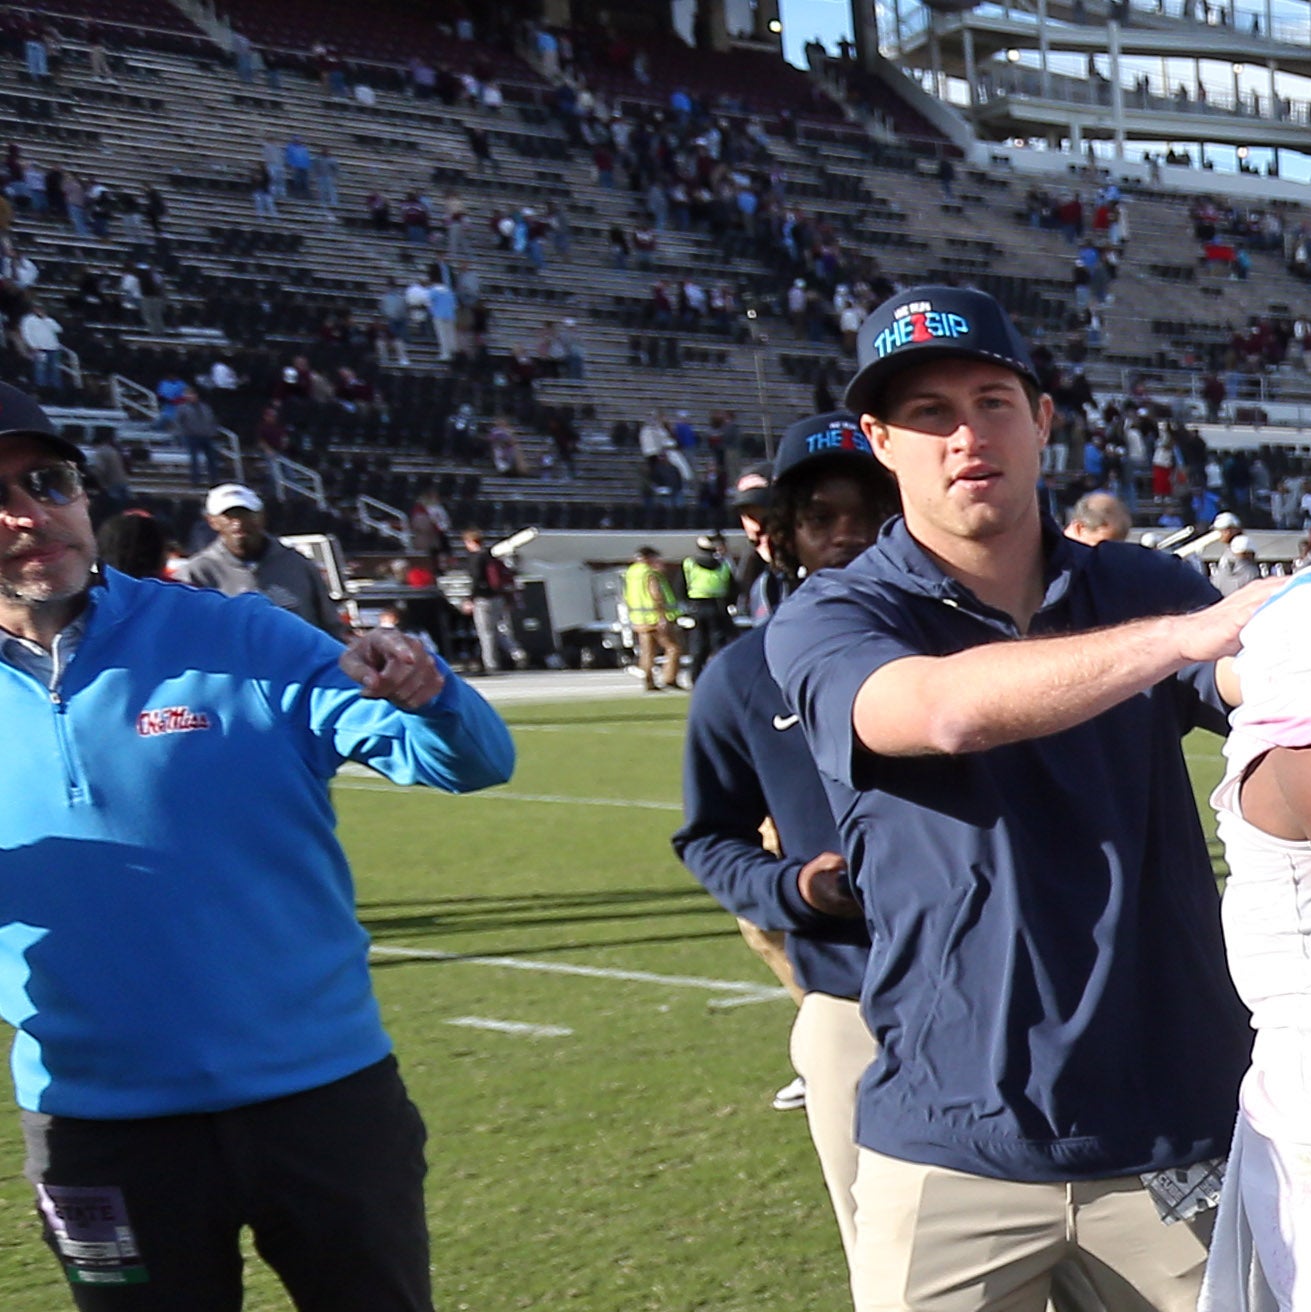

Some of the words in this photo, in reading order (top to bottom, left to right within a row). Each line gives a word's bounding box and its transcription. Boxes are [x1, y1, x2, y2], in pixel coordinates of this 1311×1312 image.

[874, 315, 914, 358] THE
[924, 311, 969, 338] SIP
[806, 429, 842, 453] THE
